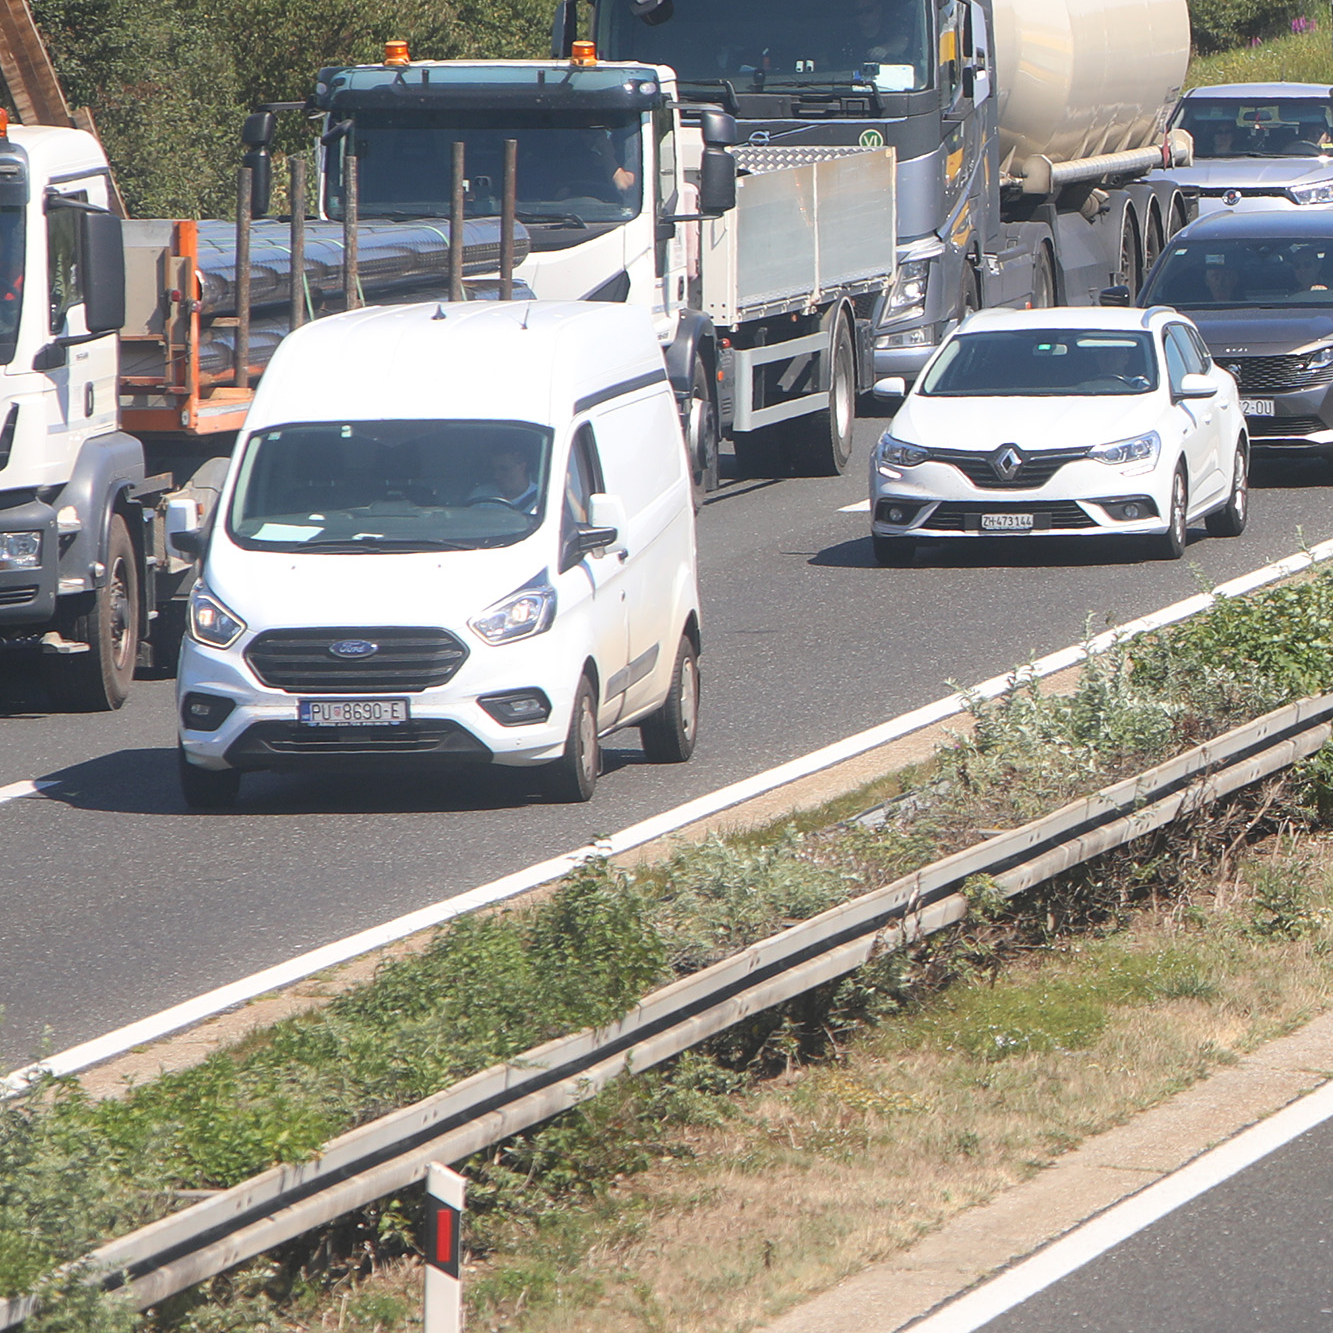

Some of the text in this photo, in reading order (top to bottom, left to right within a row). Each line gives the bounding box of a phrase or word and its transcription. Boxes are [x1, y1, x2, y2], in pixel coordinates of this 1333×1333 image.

[863, 134, 879, 147] VI
[311, 702, 400, 720] PU 8690-E
